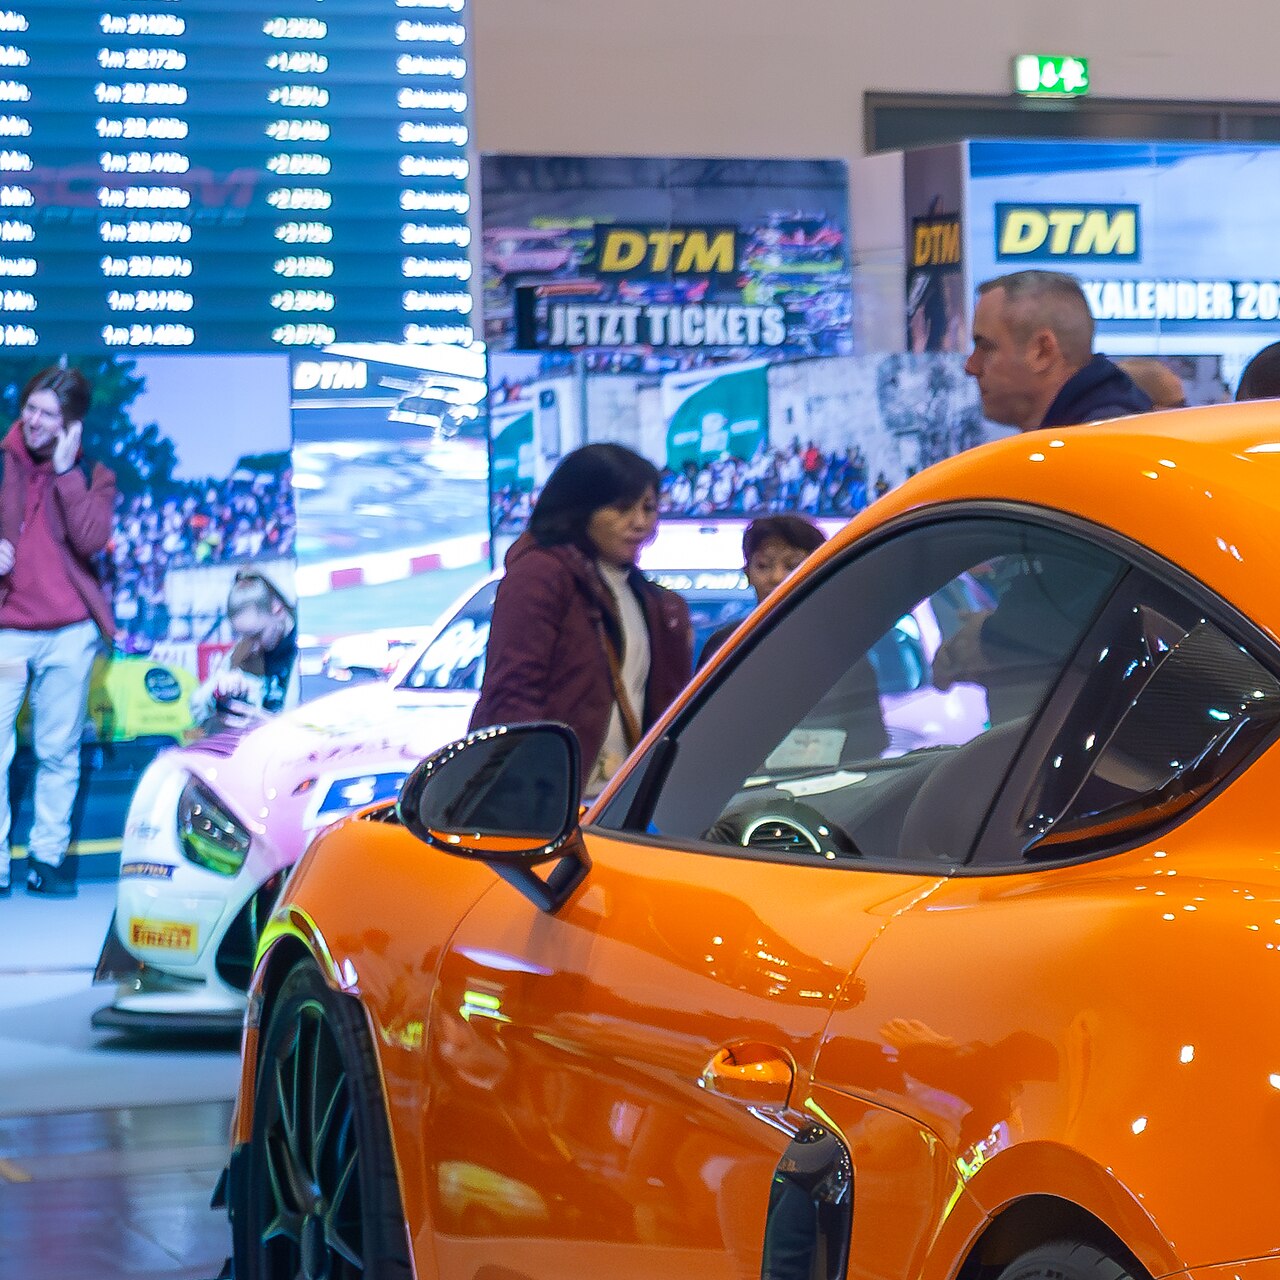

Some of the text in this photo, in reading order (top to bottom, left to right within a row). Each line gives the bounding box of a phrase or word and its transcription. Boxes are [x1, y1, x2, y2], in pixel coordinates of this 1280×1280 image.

[600, 231, 735, 273] DTM
[1000, 209, 1137, 255] DTM
[549, 306, 787, 346] JETZT TICKETS
[293, 361, 367, 390] DTM
